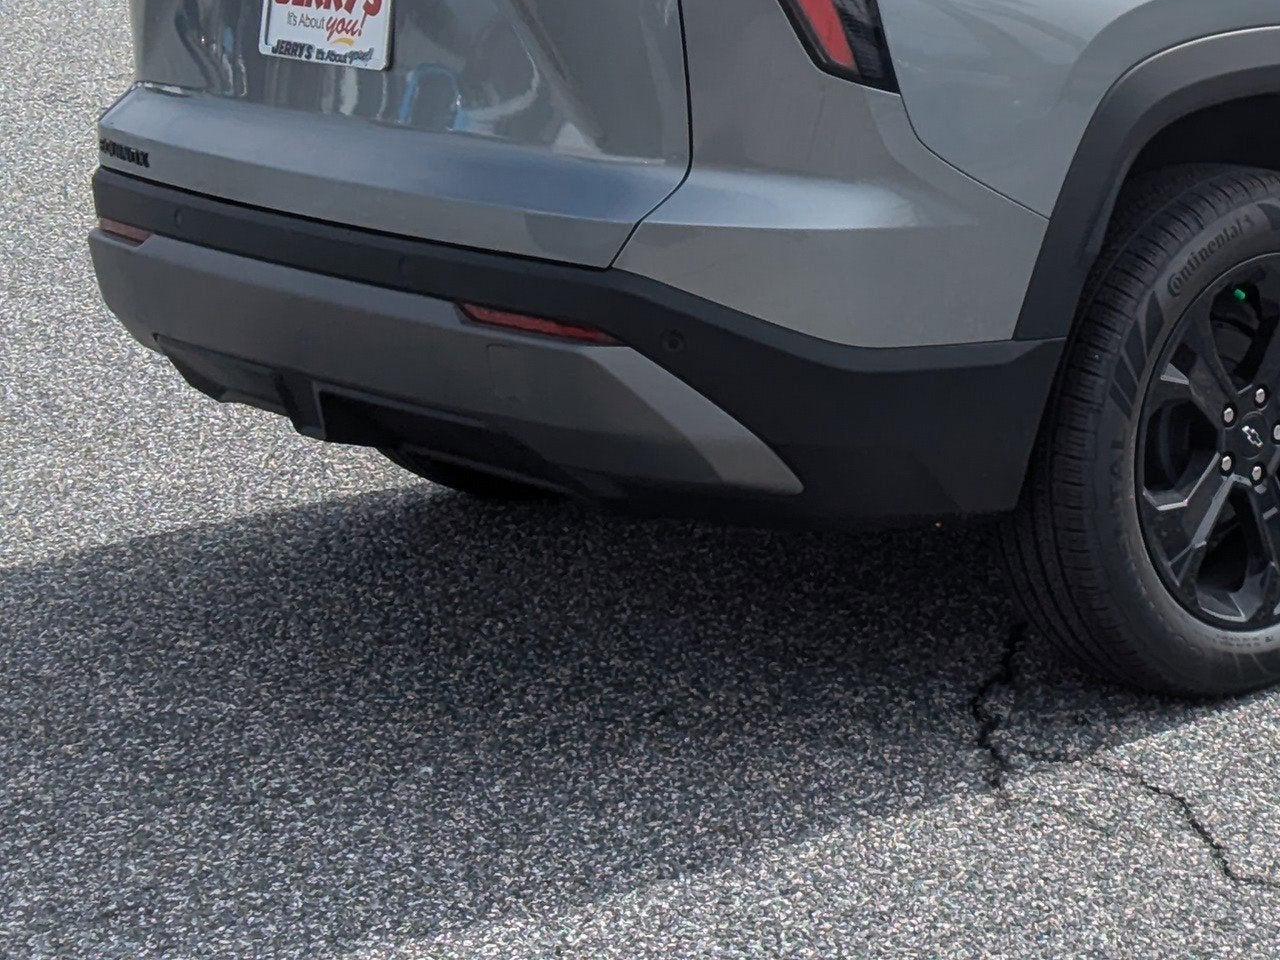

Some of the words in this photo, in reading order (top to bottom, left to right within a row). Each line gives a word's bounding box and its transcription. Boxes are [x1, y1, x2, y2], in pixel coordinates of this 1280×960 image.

[287, 10, 298, 26] It's
[298, 13, 325, 29] About
[325, 11, 367, 41] you!
[1166, 217, 1244, 298] Continental
